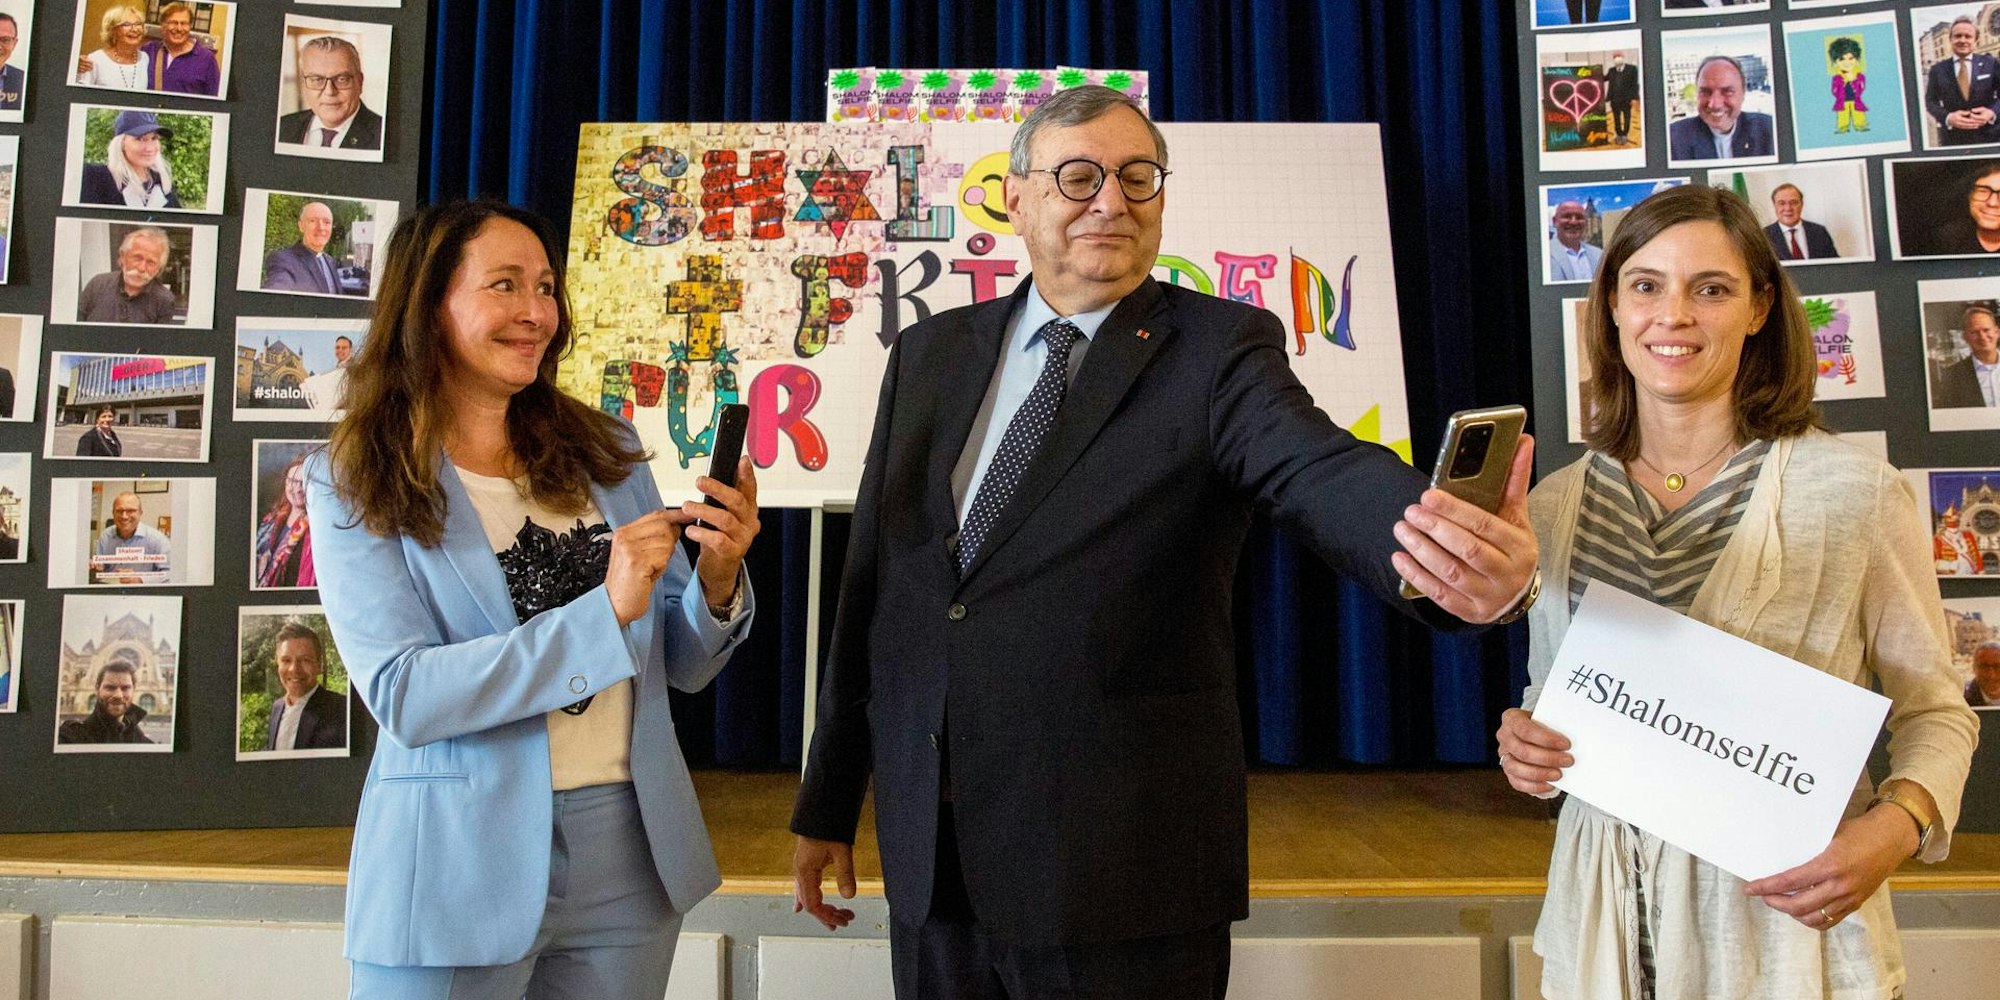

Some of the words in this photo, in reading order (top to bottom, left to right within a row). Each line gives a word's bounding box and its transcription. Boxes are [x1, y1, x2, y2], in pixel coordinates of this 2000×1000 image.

[833, 89, 877, 99] SHALOM
[838, 96, 872, 105] SELFIE
[1818, 345, 1852, 354] LFIE
[1565, 663, 1816, 796] #Shalomselfie
